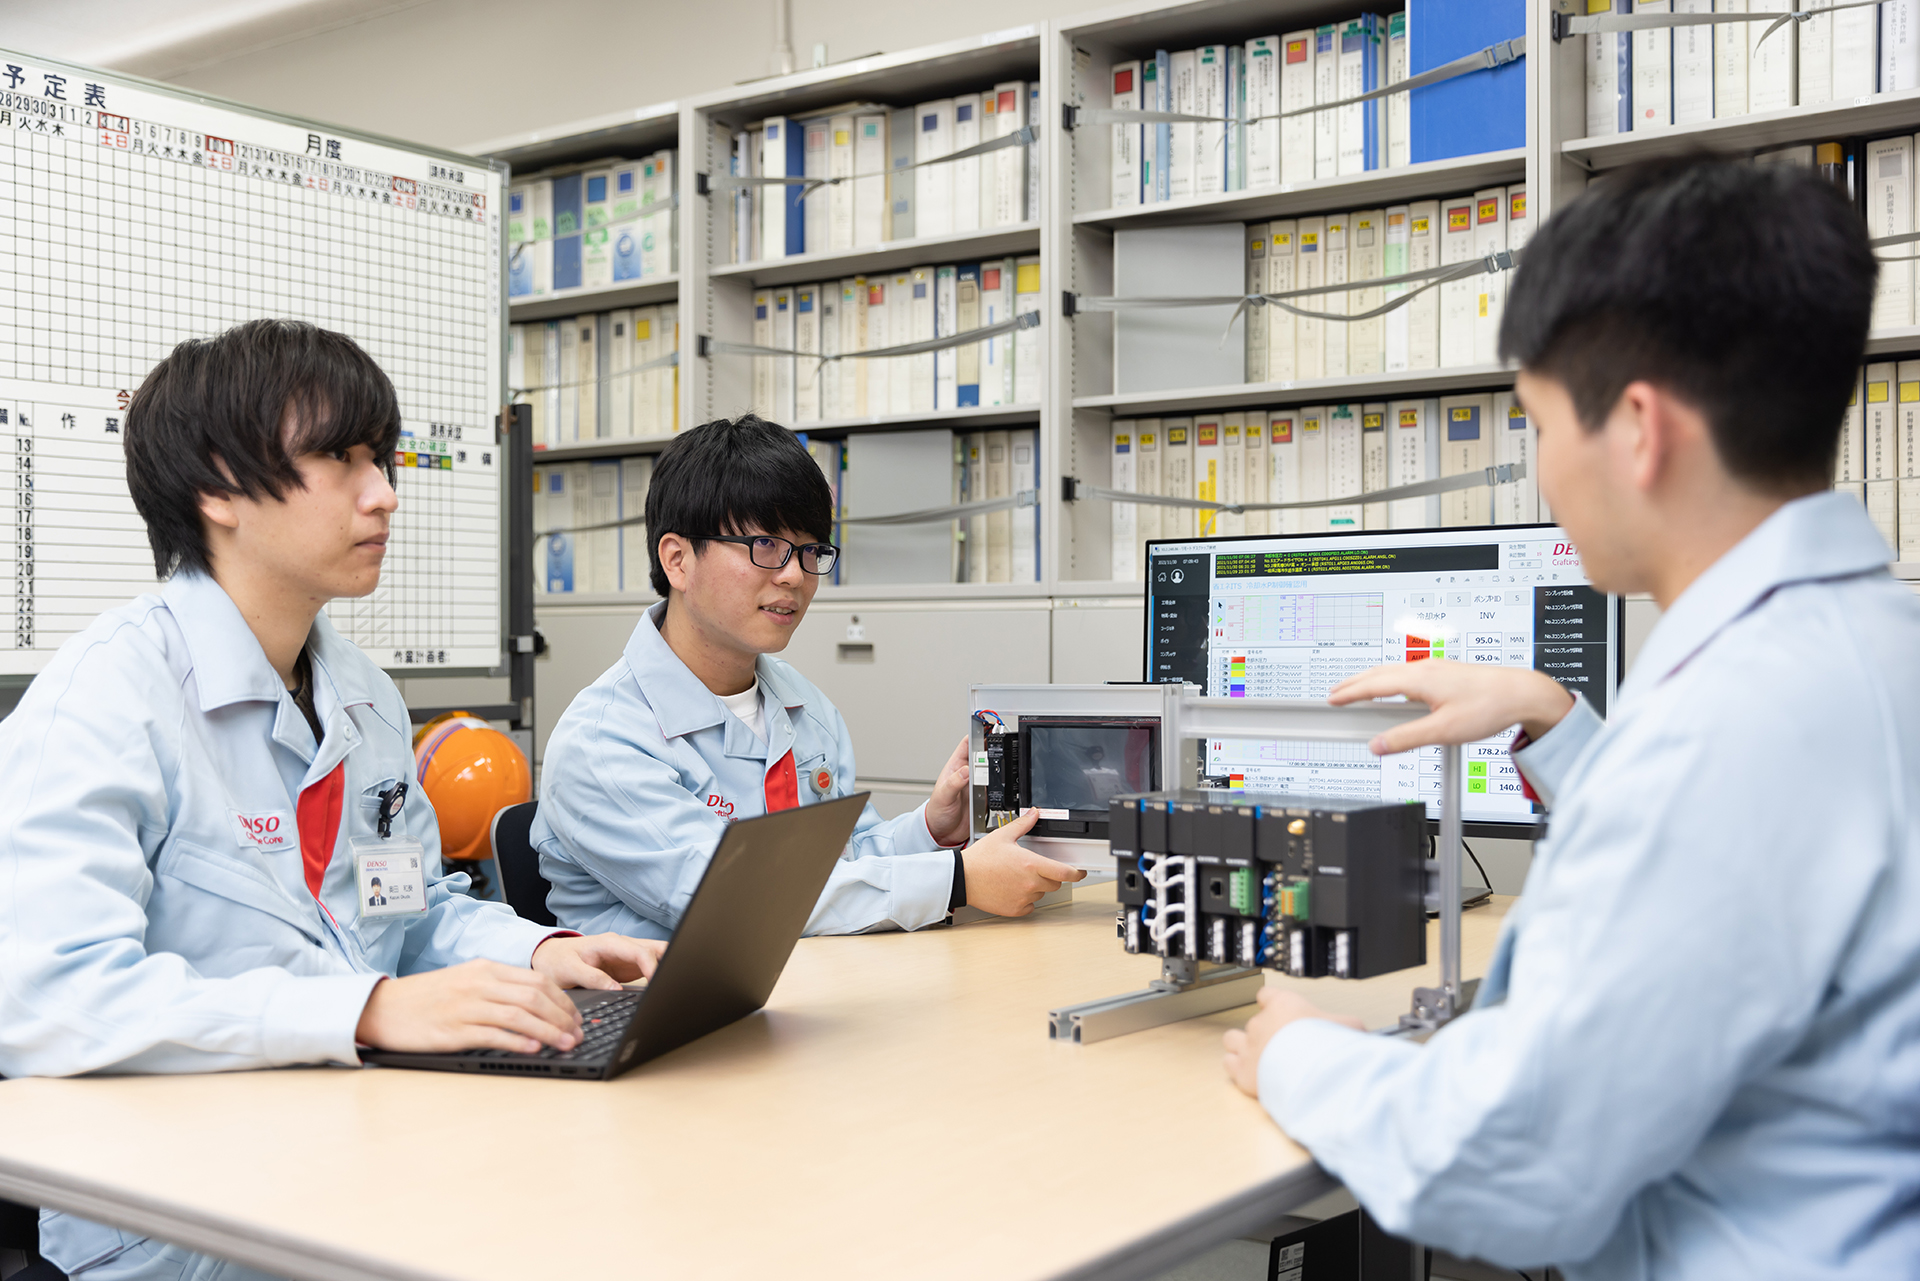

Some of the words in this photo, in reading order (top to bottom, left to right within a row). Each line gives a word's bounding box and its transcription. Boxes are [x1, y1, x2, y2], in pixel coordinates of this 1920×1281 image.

[16, 96, 30, 112] 29
[33, 100, 47, 115] 30
[50, 104, 64, 121] 31
[235, 144, 248, 158] 12
[250, 147, 260, 160] 13
[264, 150, 274, 162] 14
[277, 153, 289, 166] 15
[17, 438, 31, 452] 13
[17, 457, 31, 470] 14
[17, 475, 32, 488] 15
[17, 493, 31, 506] 16
[17, 510, 31, 523] 17
[17, 527, 31, 541] 18
[18, 545, 31, 558] 19
[1552, 558, 1579, 567] Crafting
[18, 563, 33, 576] 20
[18, 581, 33, 594] 21
[18, 599, 33, 612] 22
[18, 616, 33, 630] 23
[18, 634, 32, 647] 24
[1475, 637, 1493, 645] 95.0
[1385, 654, 1401, 662] No.2
[1475, 654, 1493, 662] 95.0
[1398, 763, 1415, 771] No.2
[1398, 780, 1415, 788] No.3
[263, 836, 284, 845] Core
[366, 860, 387, 868] DENSO
